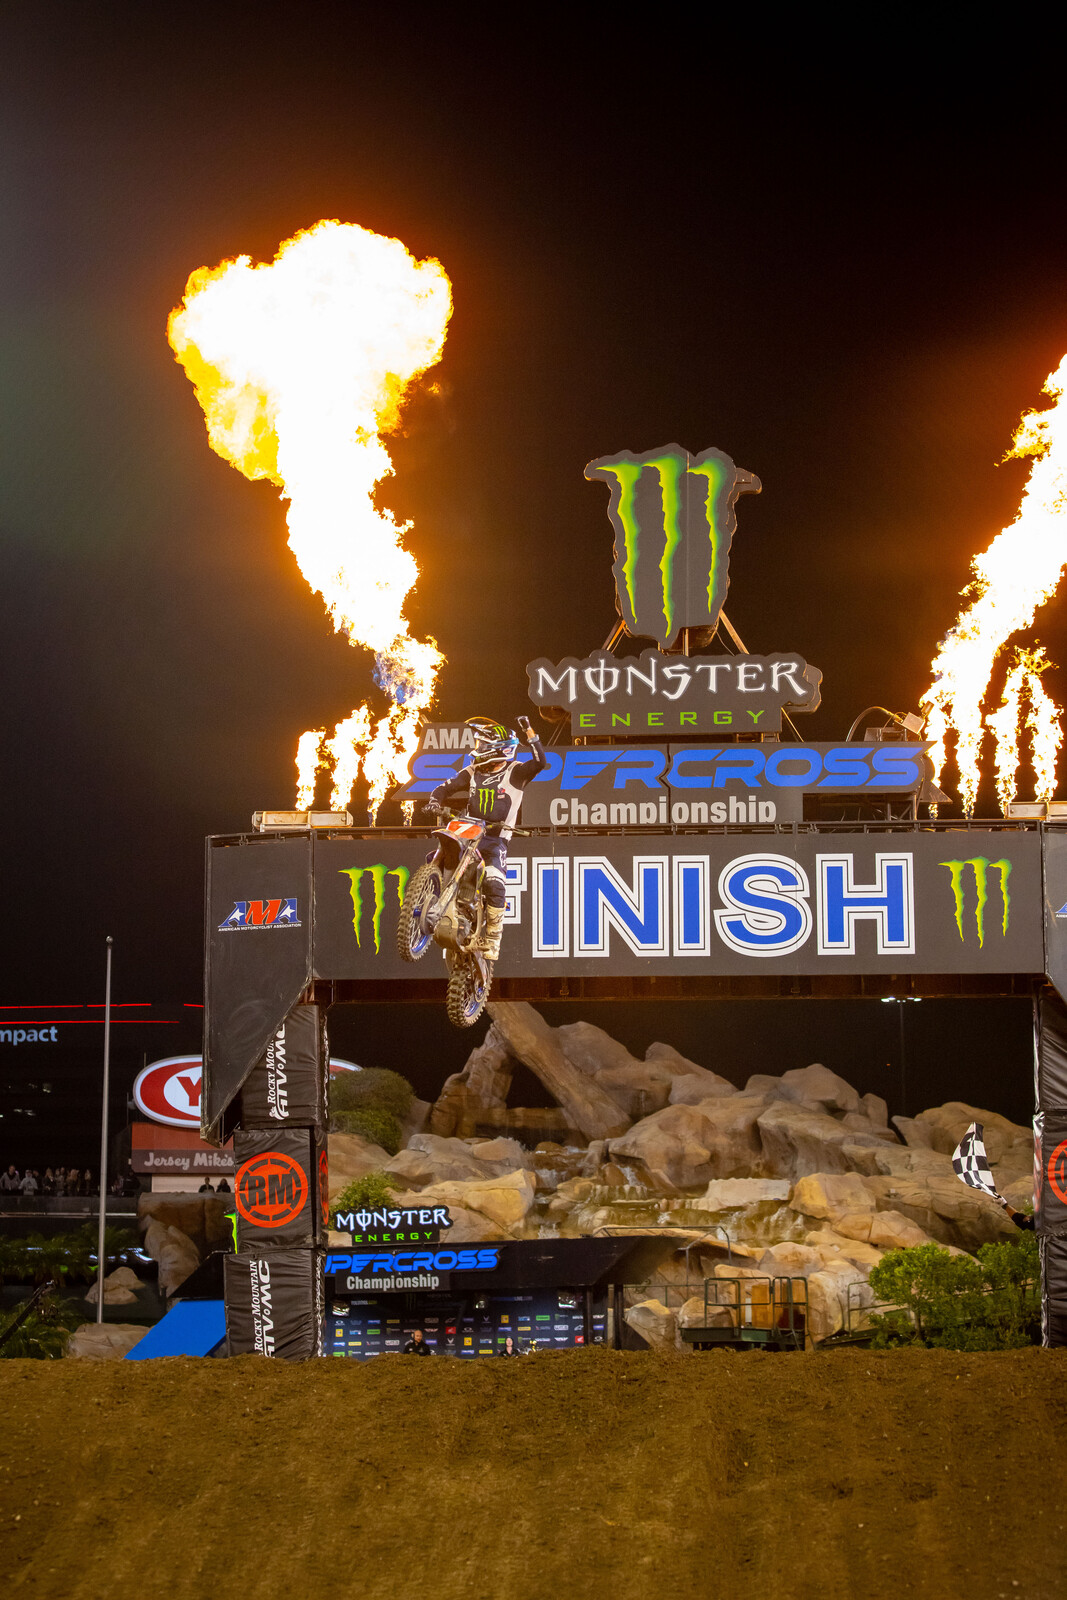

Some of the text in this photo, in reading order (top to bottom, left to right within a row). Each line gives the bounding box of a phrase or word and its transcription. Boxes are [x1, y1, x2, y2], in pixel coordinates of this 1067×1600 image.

[536, 657, 807, 705] MONSTER
[579, 709, 766, 728] ENERGY
[422, 728, 475, 750] AMA
[405, 747, 924, 793] SPERCROSS
[549, 795, 777, 825] Championship
[217, 898, 302, 927] AMA
[500, 852, 916, 958] INISH
[267, 1071, 276, 1104] ROCKY
[144, 1152, 234, 1171] Jersey Mike's
[336, 1208, 451, 1232] MONSTER
[355, 1232, 433, 1243] ENERGY
[346, 1274, 440, 1292] Championship
[249, 1259, 264, 1351] ROCKY MOUNTAIN
